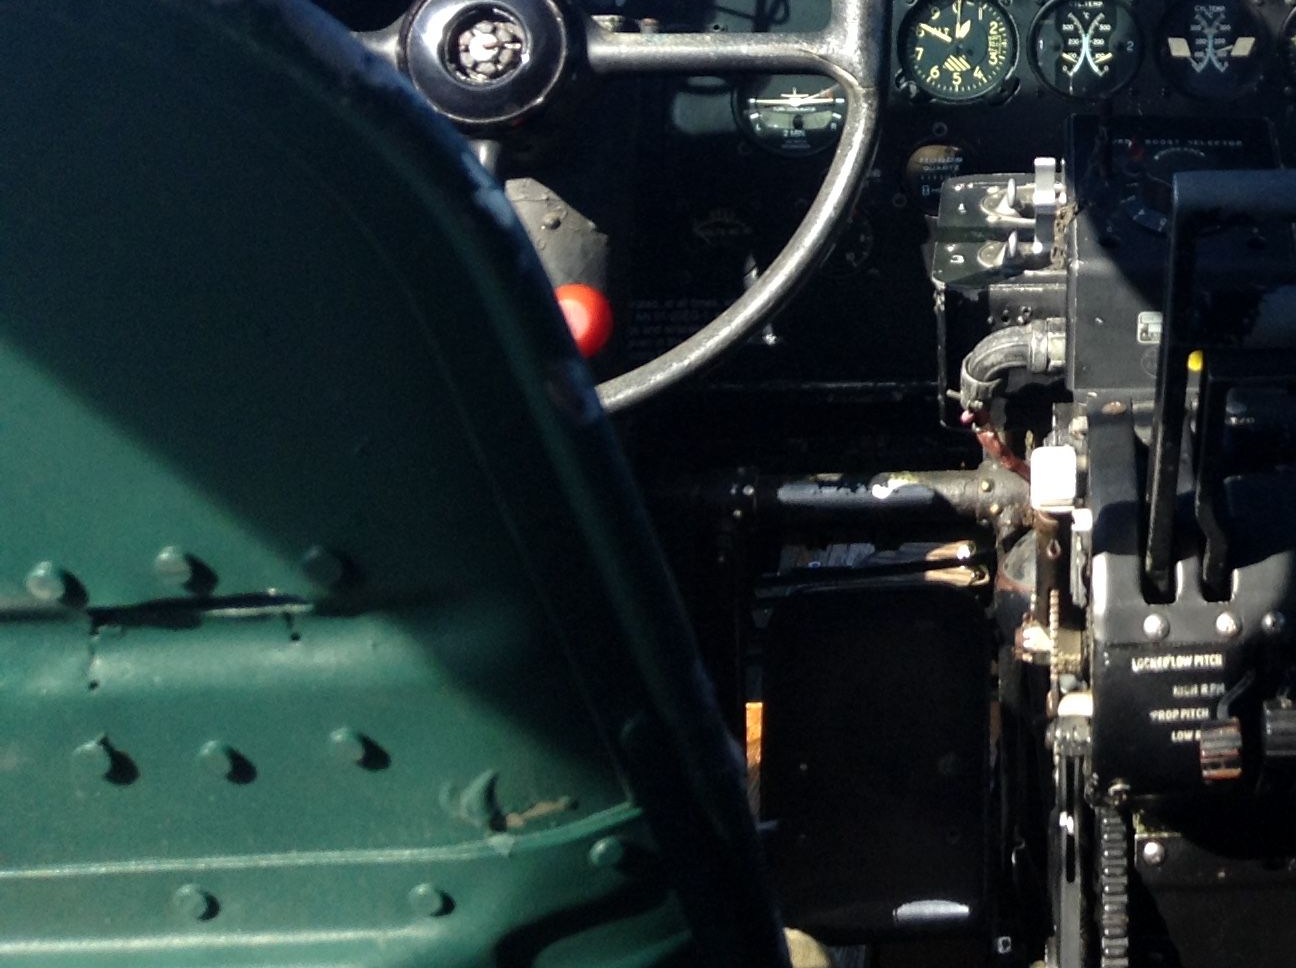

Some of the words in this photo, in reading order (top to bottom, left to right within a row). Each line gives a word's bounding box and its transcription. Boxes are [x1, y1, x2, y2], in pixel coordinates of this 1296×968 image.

[930, 6, 940, 20] 9
[978, 6, 983, 20] 1
[989, 20, 998, 34] 2
[914, 46, 924, 60] 7
[1126, 40, 1134, 52] 2
[930, 64, 940, 79] 6
[952, 72, 962, 85] 5
[973, 66, 984, 79] 4
[1132, 655, 1170, 672] LOCKED
[1170, 654, 1192, 669] LOW
[1194, 653, 1223, 668] PITCH
[1149, 709, 1180, 722] PROP
[1180, 707, 1210, 720] PITCH
[1171, 729, 1193, 743] LOW
